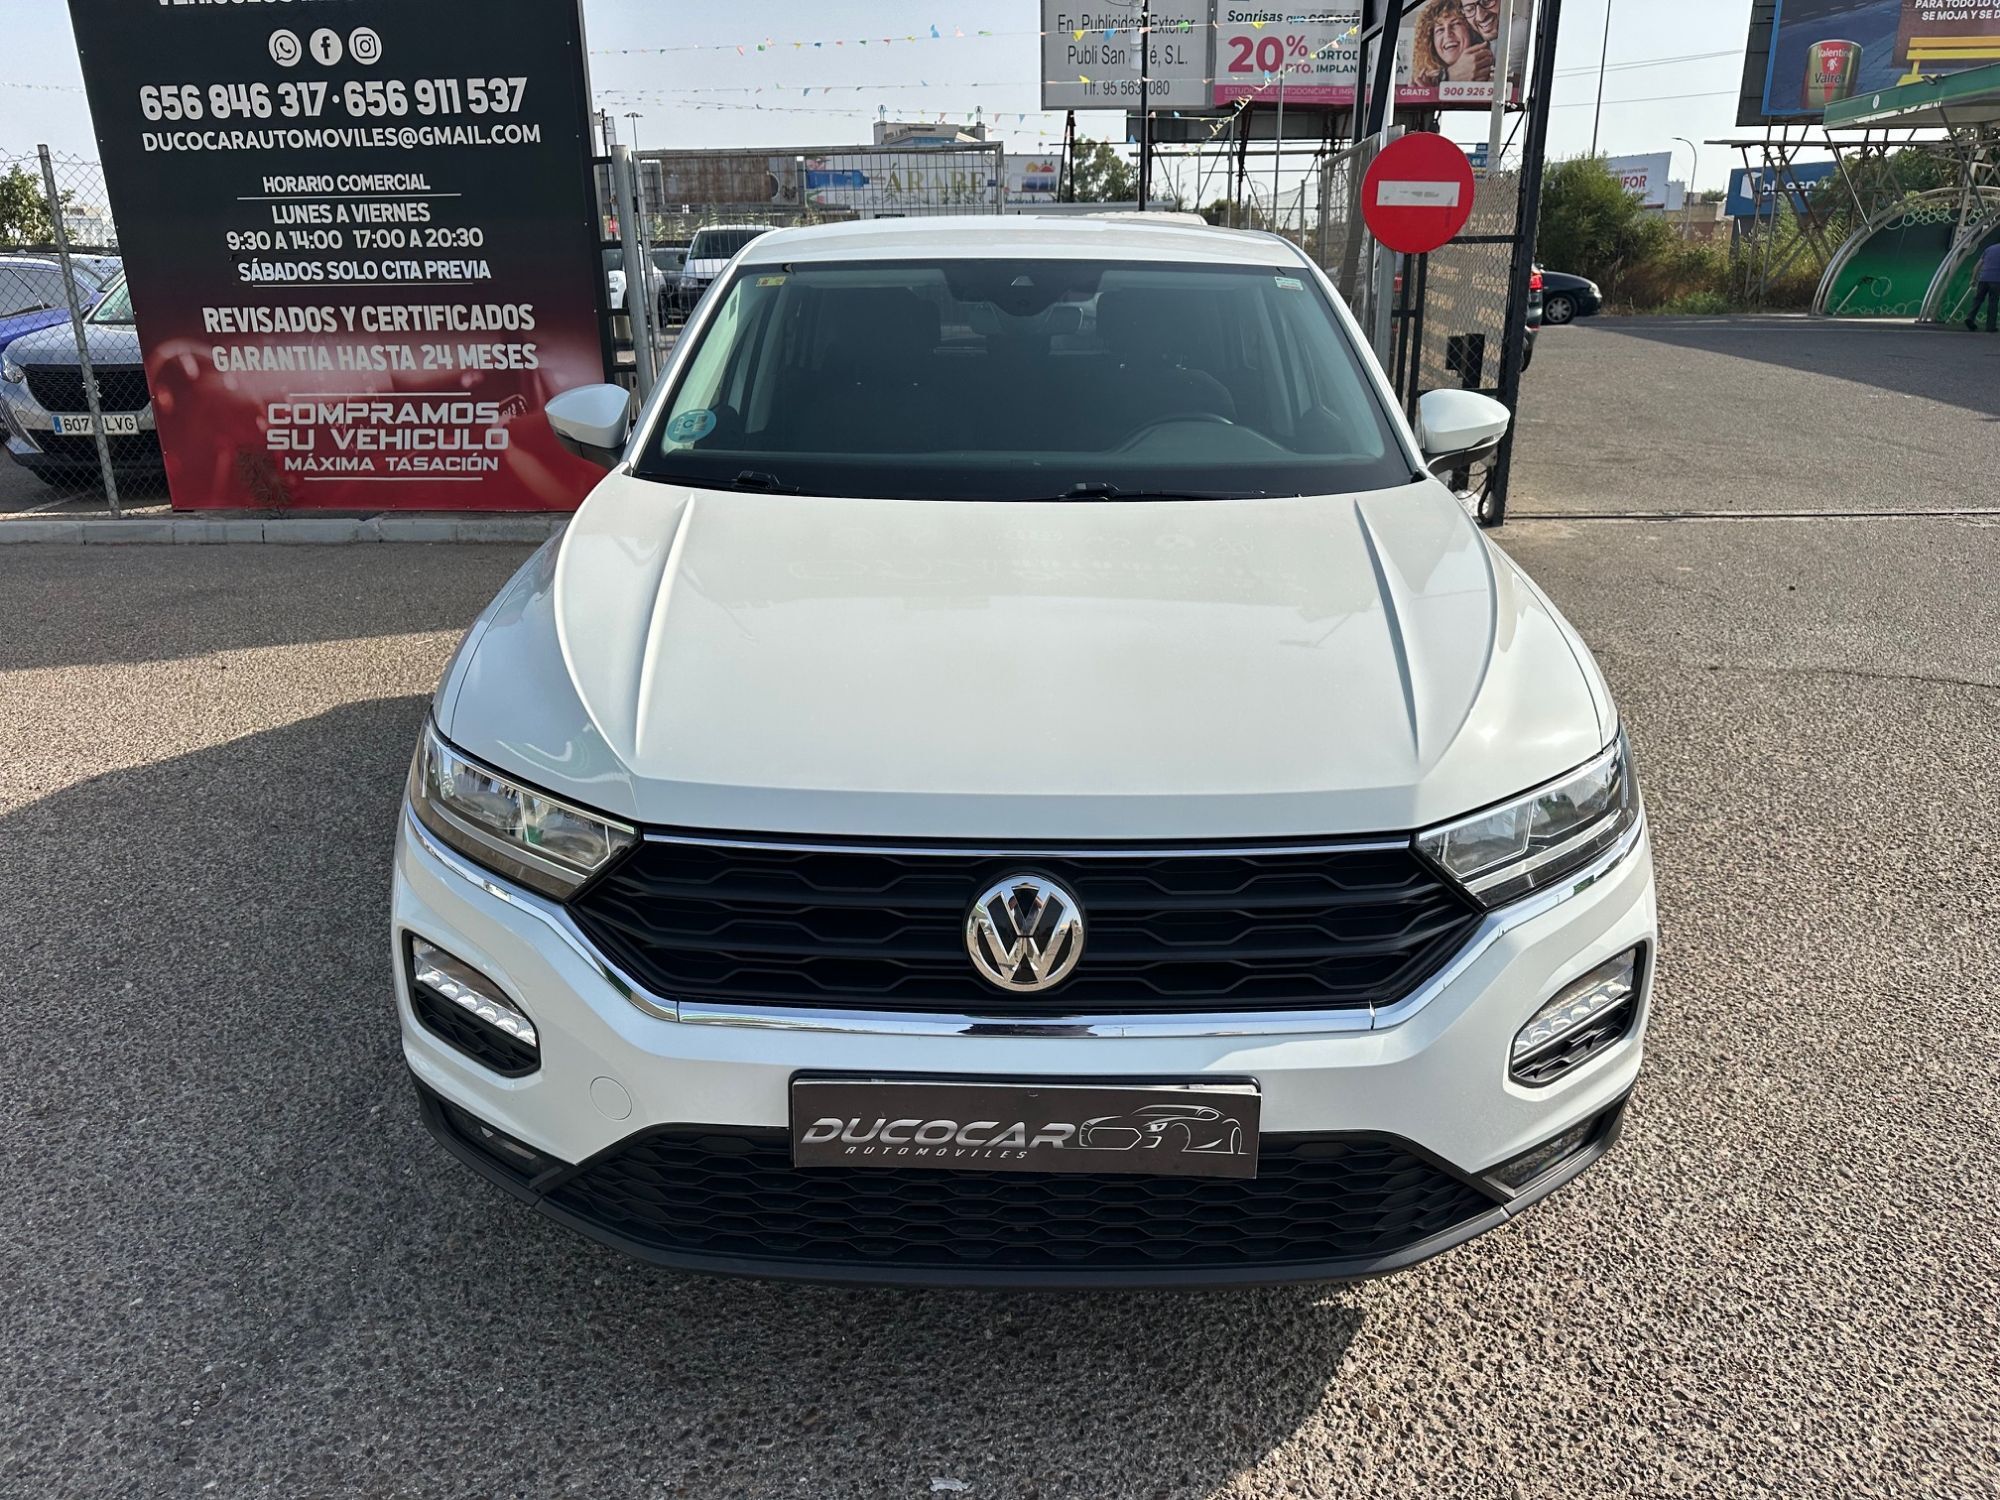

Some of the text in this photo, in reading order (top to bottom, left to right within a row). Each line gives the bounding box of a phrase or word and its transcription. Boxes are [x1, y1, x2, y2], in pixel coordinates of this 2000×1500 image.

[1915, 0, 1943, 8] PARA
[1946, 0, 1974, 8] TODO
[1058, 14, 1074, 34] En
[1228, 10, 1283, 22] Sonrisas
[1922, 11, 1936, 20] SE
[1937, 10, 1967, 20] MOJA
[1970, 10, 1978, 19] Y
[1979, 10, 1992, 19] SE
[1067, 45, 1098, 65] Publi
[1101, 45, 1125, 65] San
[1164, 45, 1188, 65] S.L.
[1103, 81, 1117, 95] 95
[1400, 88, 1431, 96] GRATIS
[1444, 87, 1464, 96] 900
[1467, 87, 1484, 96] 926
[139, 77, 527, 121] 656 846 317 656 911 537
[142, 124, 541, 152] DUCOCARAUTOMOVILES@GMAIL.COM
[262, 173, 431, 193] HORARIO COMERCIAL
[271, 203, 431, 224] LUNES A VIERNES
[226, 227, 484, 250] 9:30 A 14:00 17:00 A 20:30
[237, 258, 492, 282] SÁBADOS SOLO CITA PREVIA
[202, 303, 536, 333] REVISADOS Y CERTIFICADOS
[211, 343, 540, 372] GARANTIA HASTA 24 MESES
[267, 402, 500, 425] COMPRAMOS
[104, 417, 135, 431] LVG
[266, 428, 509, 450] SU VEHICULO
[284, 452, 499, 472] MÁXIMA TASACIÓN
[801, 1117, 1076, 1149] DUCOCAR
[844, 1146, 1028, 1160] AUTOMÓVILES
